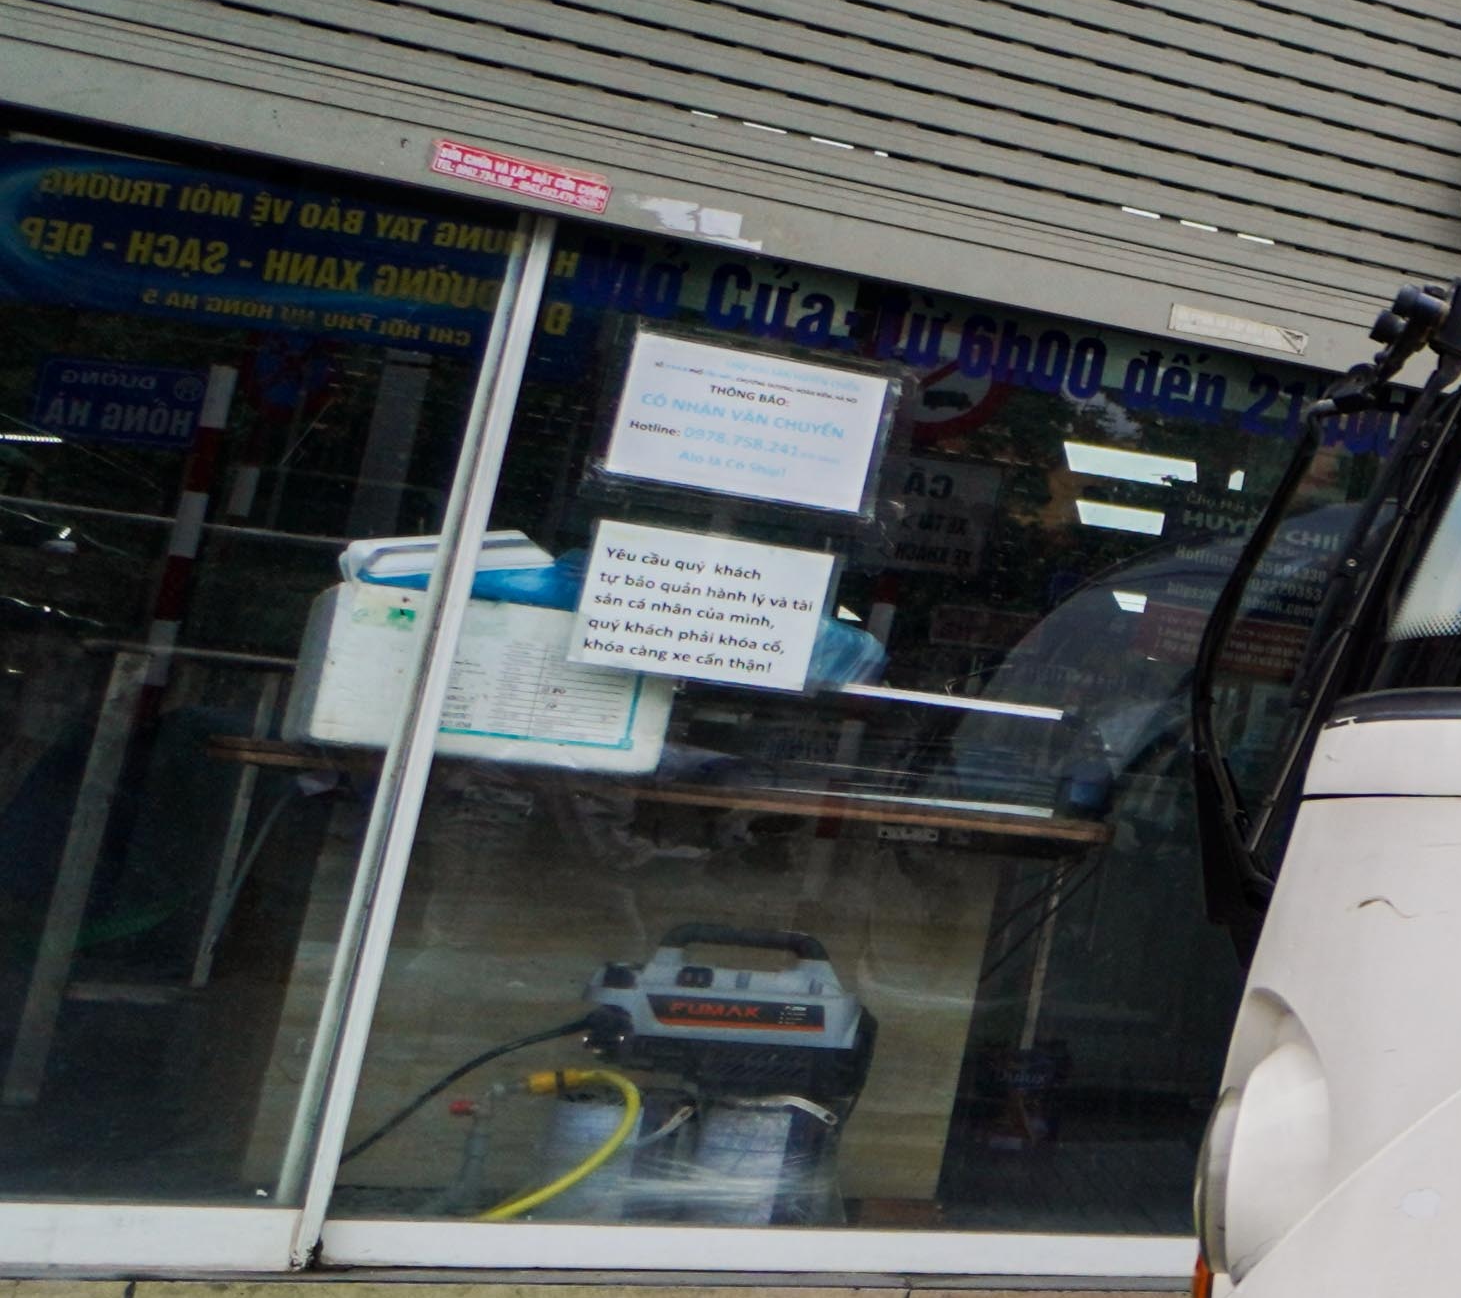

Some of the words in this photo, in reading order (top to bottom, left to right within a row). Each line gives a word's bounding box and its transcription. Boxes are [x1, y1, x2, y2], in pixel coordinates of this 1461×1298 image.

[959, 313, 1108, 399] 6h00
[1123, 348, 1229, 424] đến
[709, 383, 756, 401] THÔNG
[629, 418, 681, 438] Hotline:
[606, 547, 637, 563] Yêu
[641, 552, 670, 567] cầu
[674, 558, 706, 574] quý
[713, 563, 762, 581] khách
[600, 572, 620, 586] tự
[624, 575, 656, 590] bảo
[660, 580, 702, 597] quản
[706, 586, 747, 604] hành
[751, 592, 767, 608] lý
[770, 597, 789, 610] và
[792, 598, 815, 613] tài
[594, 592, 623, 607] sản
[627, 597, 646, 611] cá
[650, 600, 692, 616] nhân
[696, 606, 725, 621] của
[730, 613, 777, 630] mình,
[588, 618, 620, 633] quý
[624, 619, 674, 639] khách
[678, 627, 714, 648] phải
[718, 633, 758, 651] khóa
[583, 637, 625, 654] khóa
[629, 644, 669, 662] càng
[672, 652, 692, 663] xe
[729, 656, 773, 674] thận!
